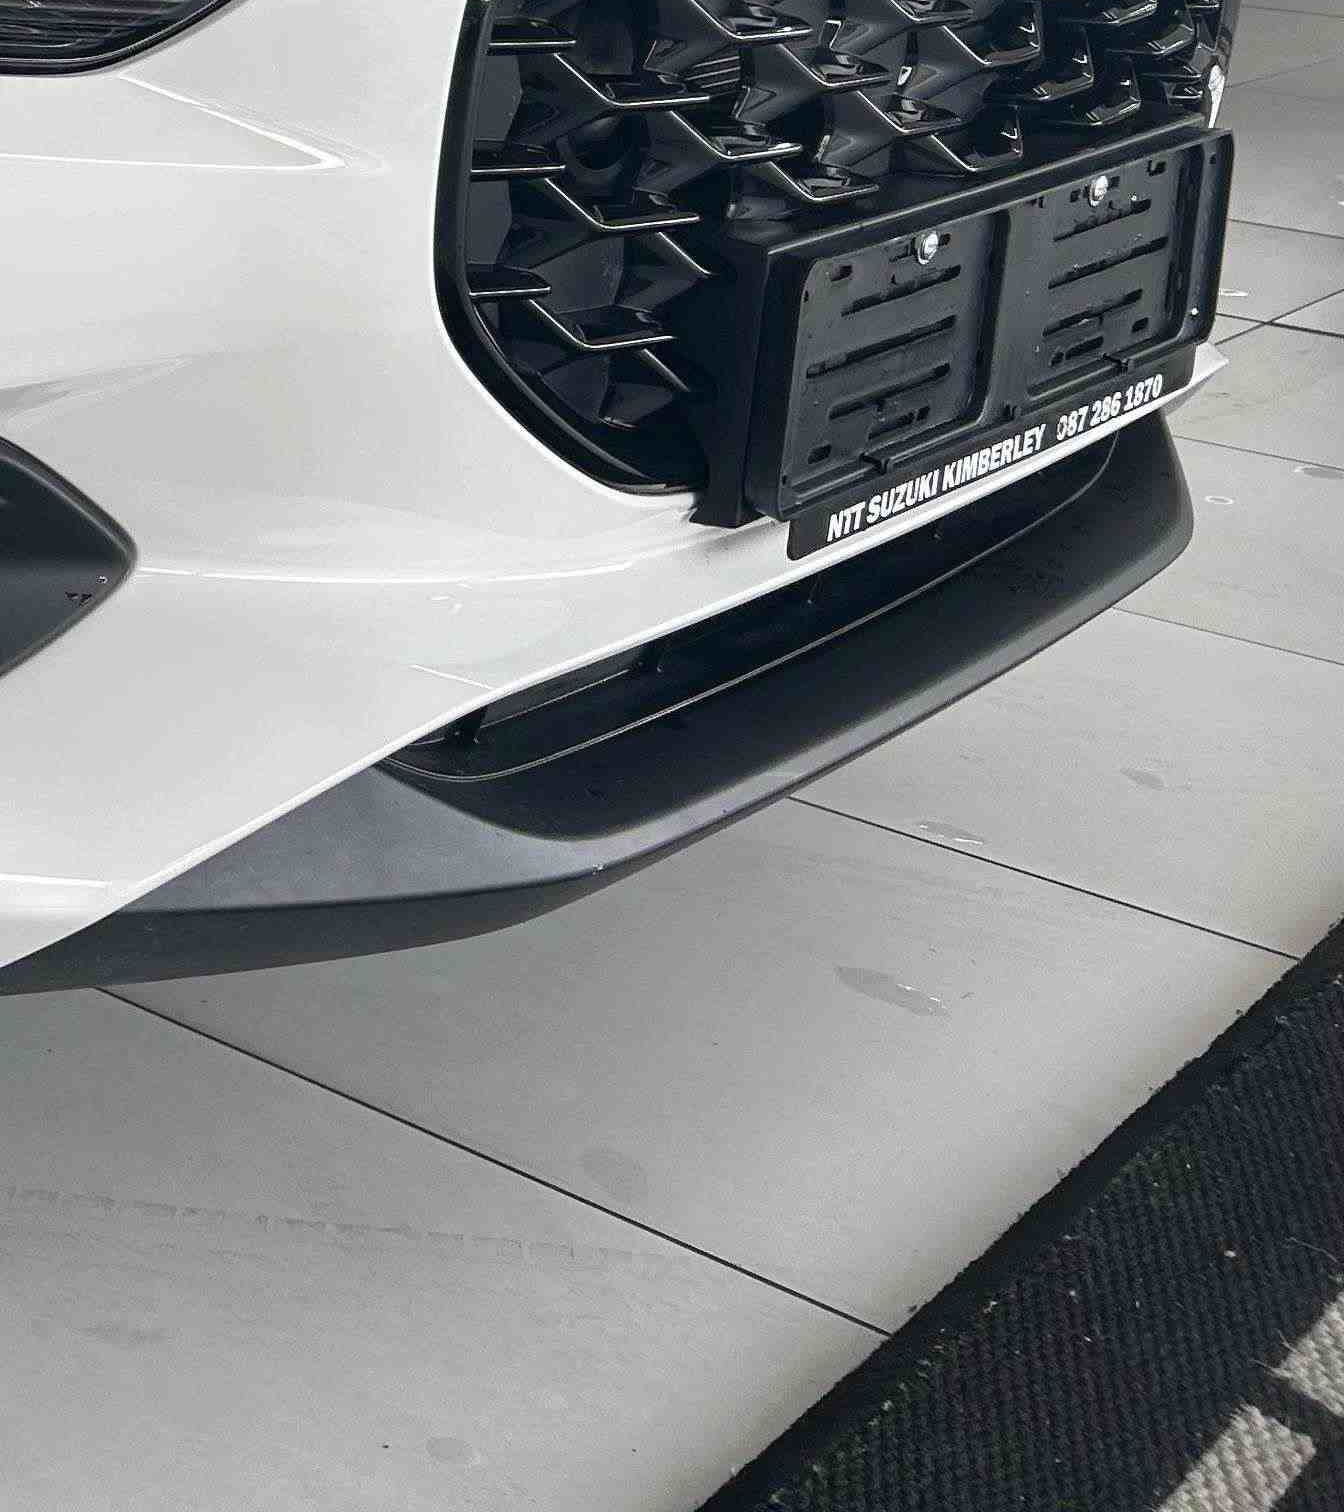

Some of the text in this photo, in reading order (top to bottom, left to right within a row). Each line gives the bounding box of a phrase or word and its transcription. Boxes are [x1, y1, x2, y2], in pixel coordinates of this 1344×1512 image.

[826, 373, 1163, 542] NTT SUZUKI KIMBERLEY 087 286 1870
